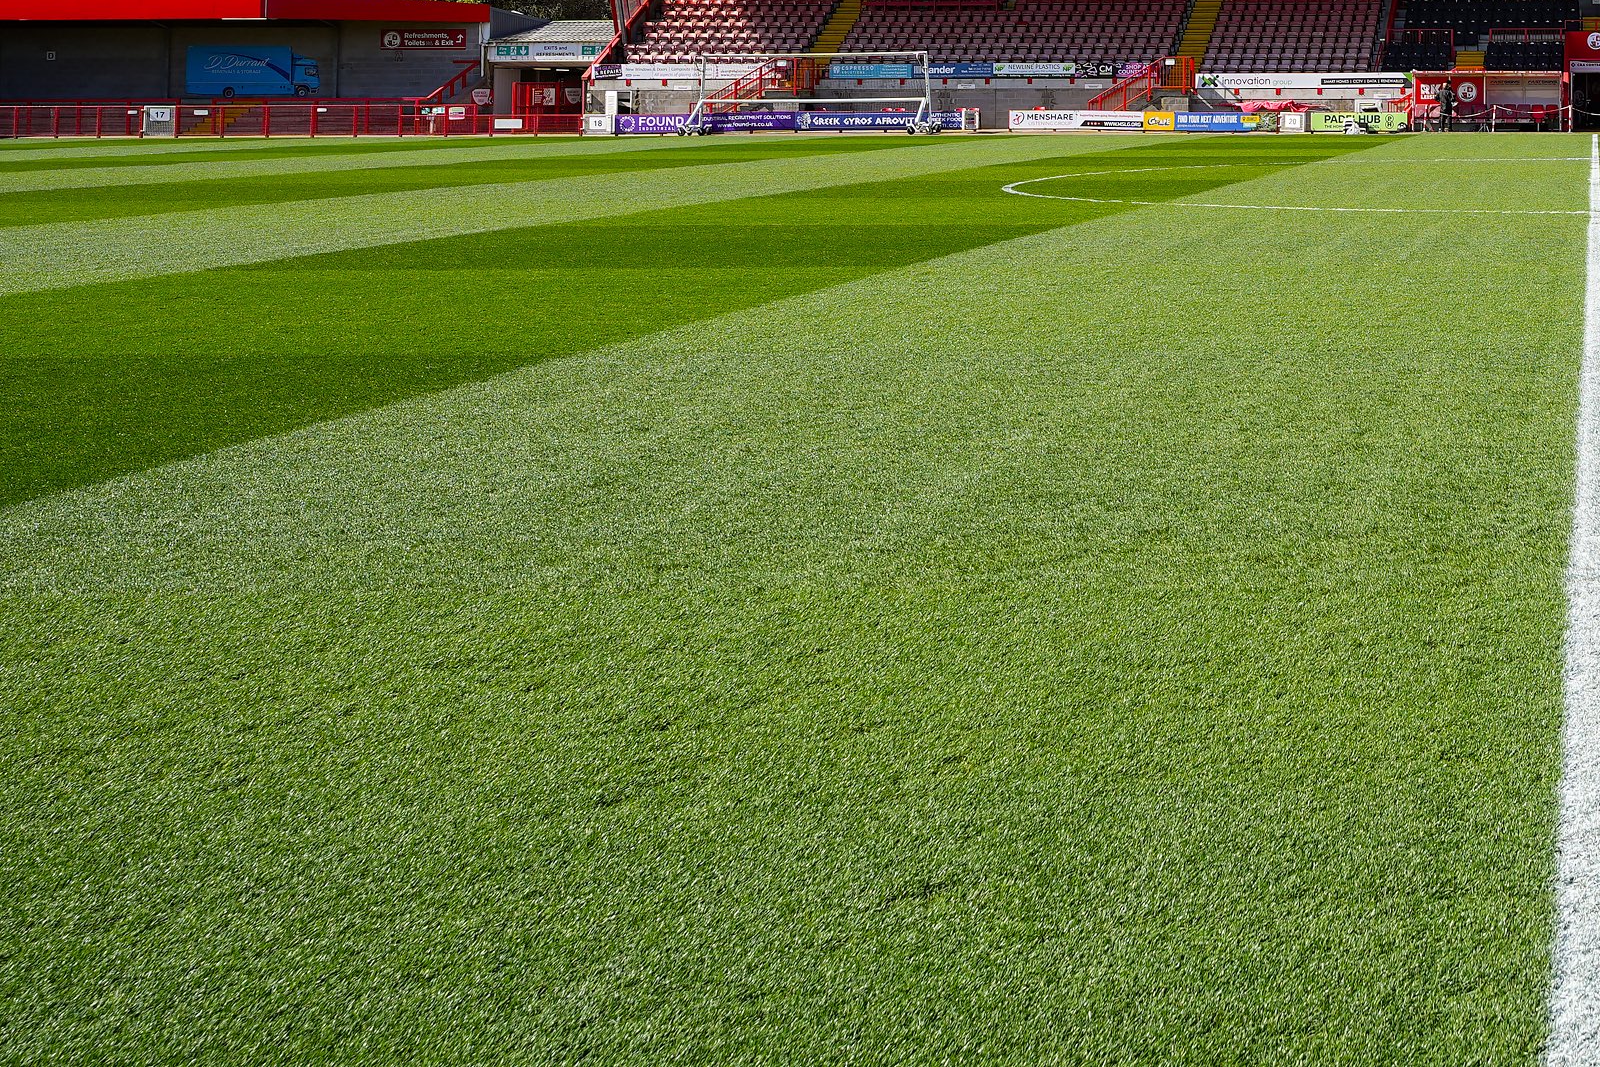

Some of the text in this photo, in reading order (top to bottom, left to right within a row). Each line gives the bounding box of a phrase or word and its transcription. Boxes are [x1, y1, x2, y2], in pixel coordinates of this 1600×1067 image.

[220, 54, 273, 70] Durrant
[1222, 76, 1292, 86] innovation group
[1420, 84, 1441, 94] RK
[638, 116, 684, 126] FOUND
[812, 116, 840, 126] GREEK
[843, 116, 872, 126] GYROS
[1177, 114, 1188, 124] FIND
[1188, 114, 1200, 124] YOUR
[1200, 114, 1212, 124] NEXT
[1212, 114, 1238, 124] ADVENTURE
